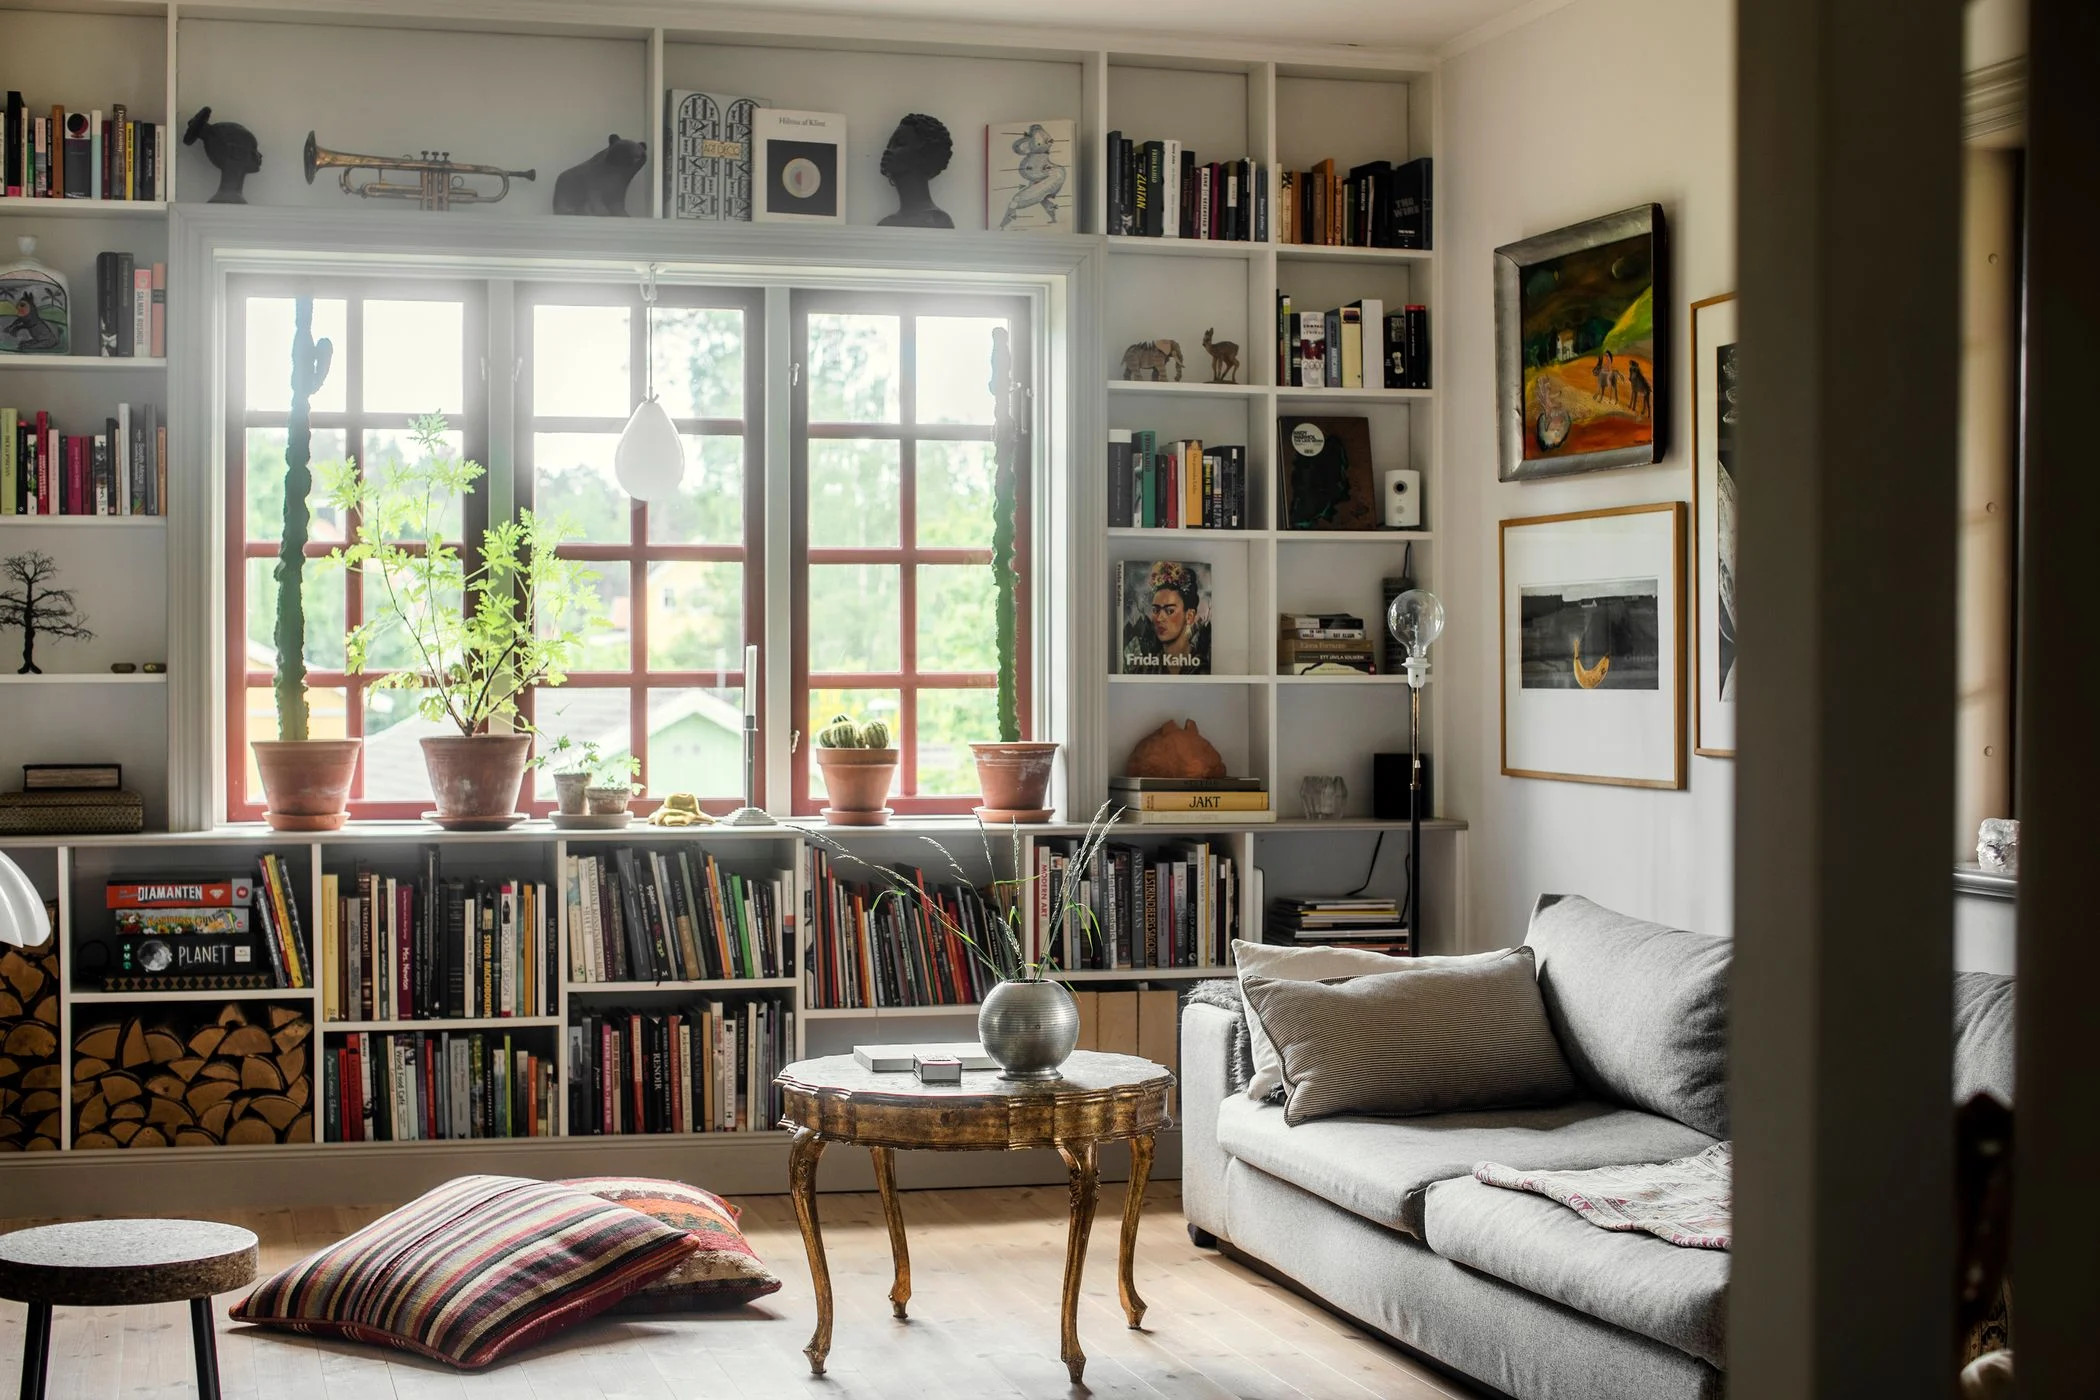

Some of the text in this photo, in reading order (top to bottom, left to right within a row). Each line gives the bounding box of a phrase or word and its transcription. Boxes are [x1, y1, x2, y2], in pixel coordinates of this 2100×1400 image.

[1136, 174, 1147, 209] ZLATAN
[136, 291, 144, 345] SALMAN RUSHDIE
[1126, 653, 1200, 666] Frida Kahlo
[1189, 796, 1220, 808] JAKT
[138, 886, 203, 901] DIAMANTEN
[1135, 852, 1143, 928] SVENSKT GLAS
[179, 943, 231, 967] PLANET
[402, 947, 410, 962] Mrs.
[402, 963, 410, 991] Newton
[483, 934, 493, 1013] STORA MACHOBOKEN
[653, 1053, 662, 1091] RENOIR
